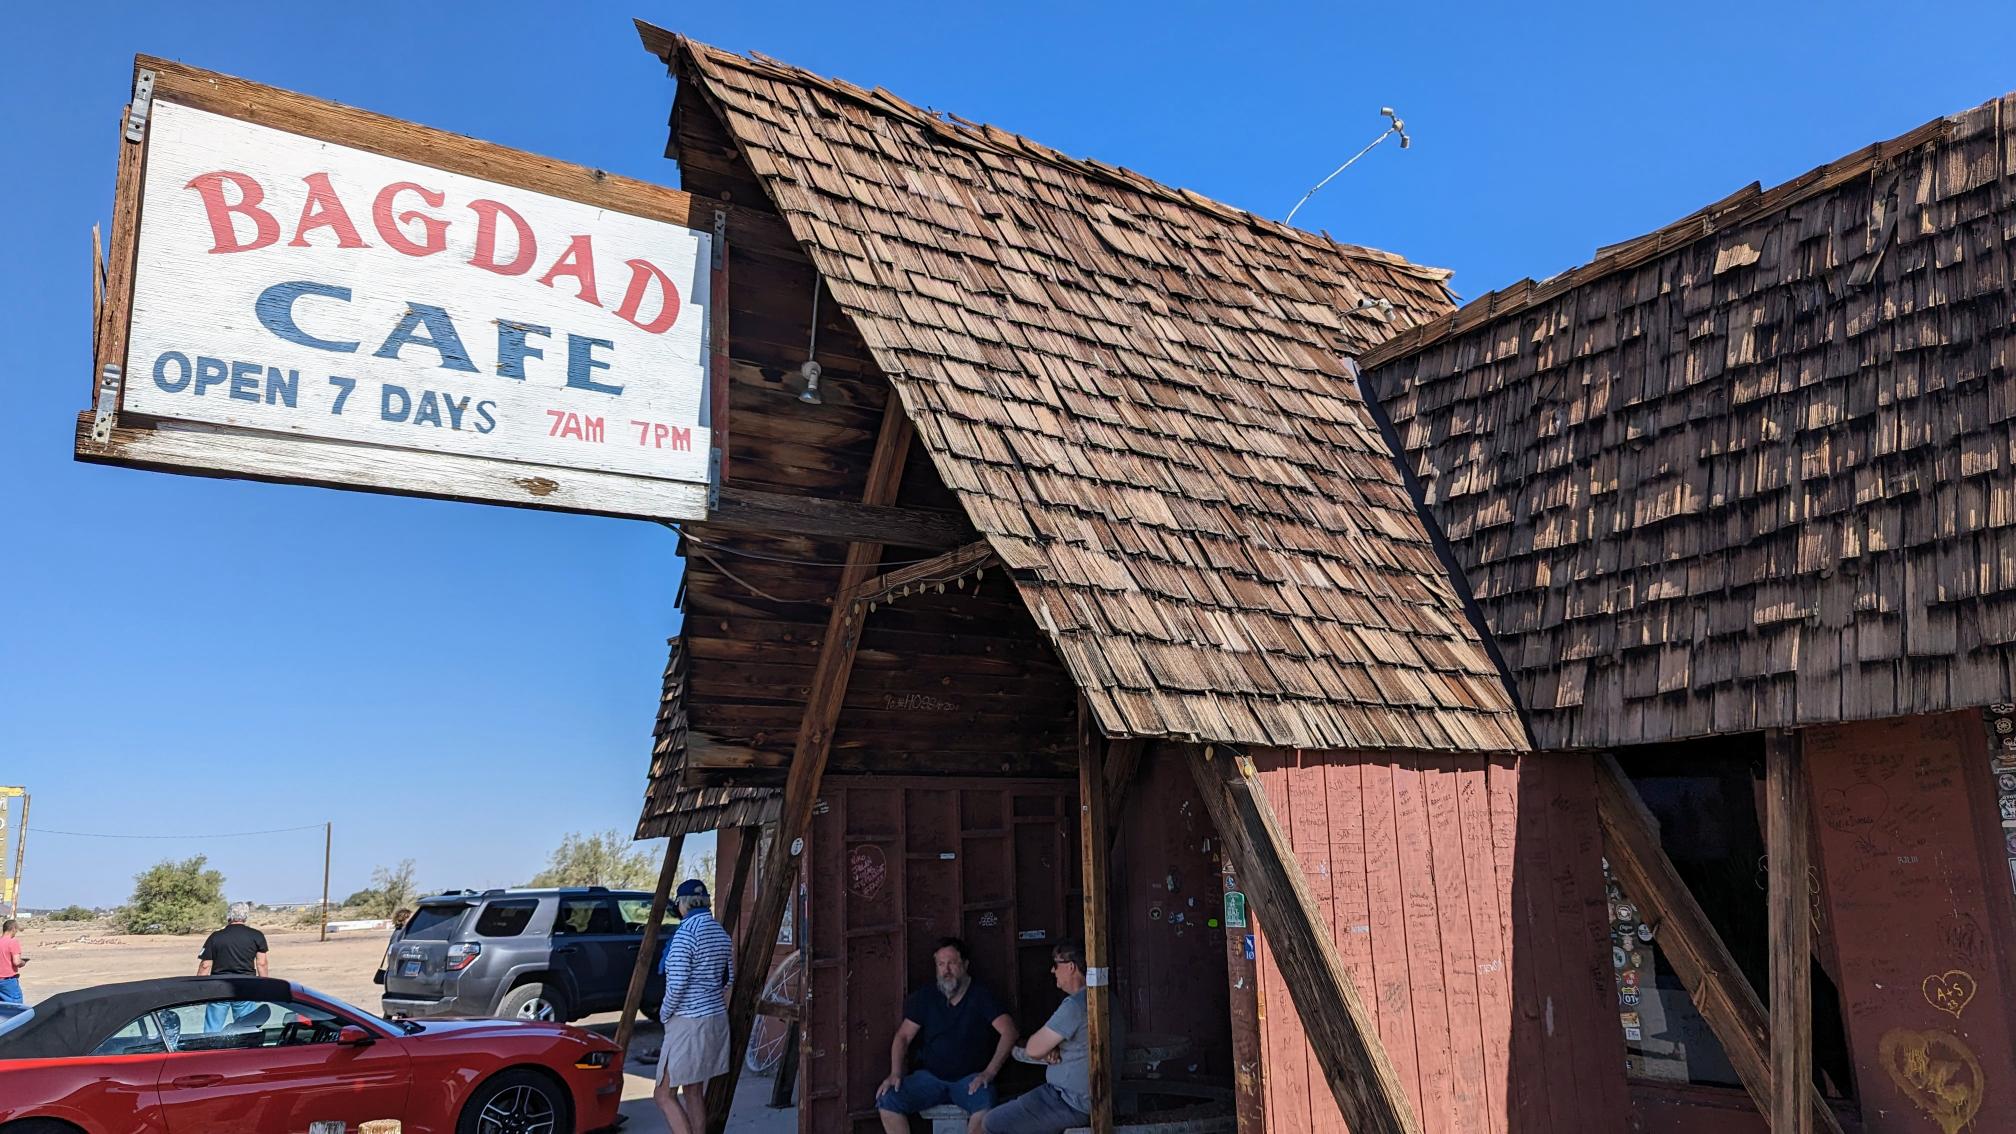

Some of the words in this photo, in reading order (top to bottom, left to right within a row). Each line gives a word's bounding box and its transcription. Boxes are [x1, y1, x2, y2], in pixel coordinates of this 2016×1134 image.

[183, 170, 681, 335] BAGDAD
[255, 280, 624, 396] CAFE
[152, 351, 299, 408] OPEN
[328, 376, 357, 416] 7
[381, 385, 497, 435] DAYS
[546, 409, 605, 444] 7AM
[630, 419, 692, 453] 7PM
[1245, 951, 1255, 960] 10
